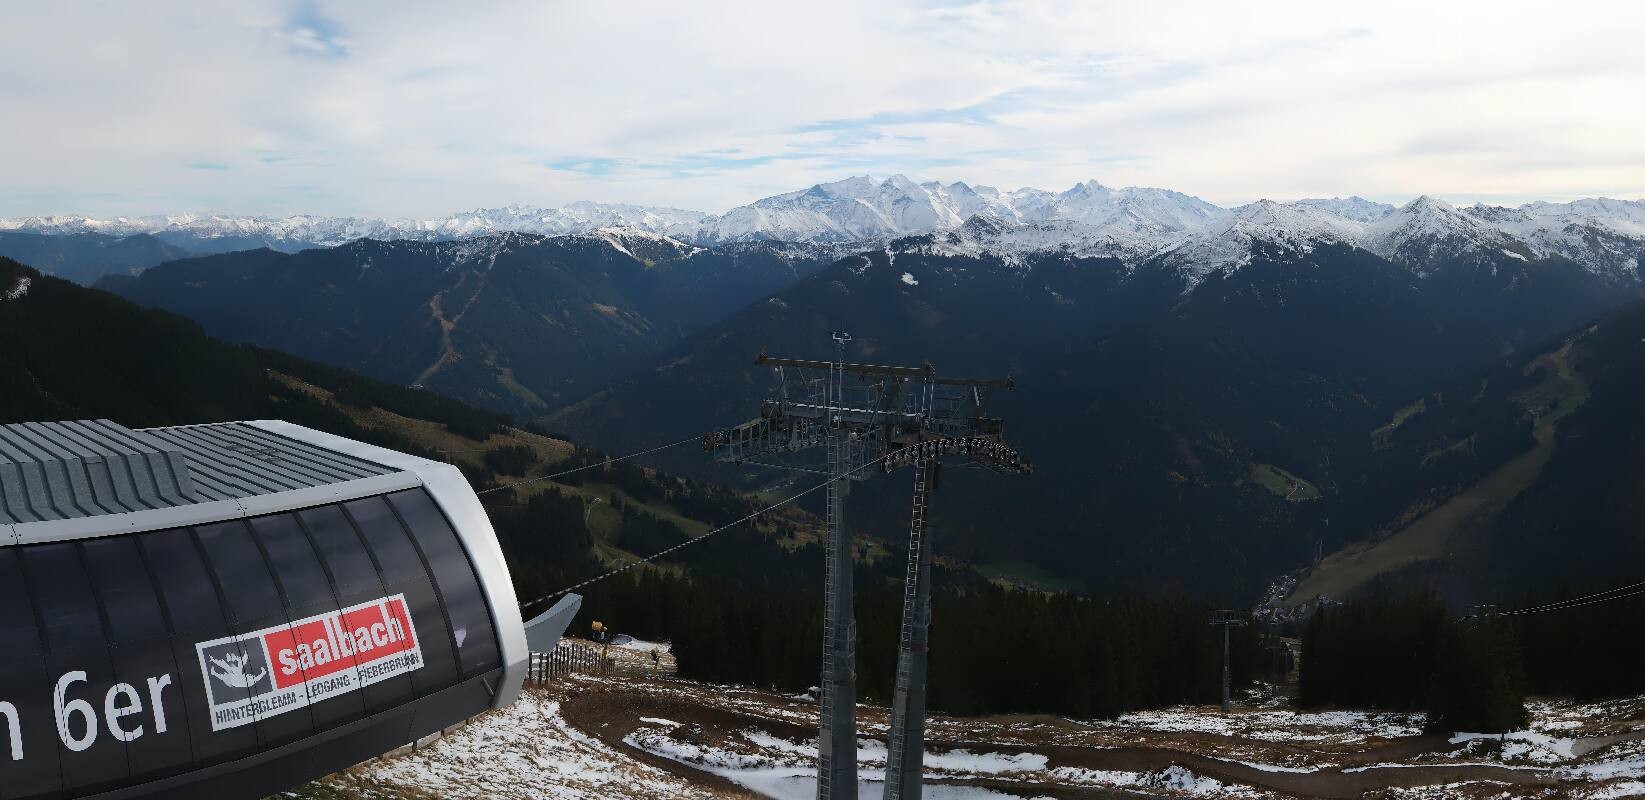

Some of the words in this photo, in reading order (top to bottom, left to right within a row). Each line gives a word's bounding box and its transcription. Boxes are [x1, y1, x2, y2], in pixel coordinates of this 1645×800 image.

[278, 602, 405, 676] saalbach
[54, 671, 171, 751] 6er
[307, 675, 351, 700] LEOGANG
[358, 653, 420, 683] FIEBERBRUNN
